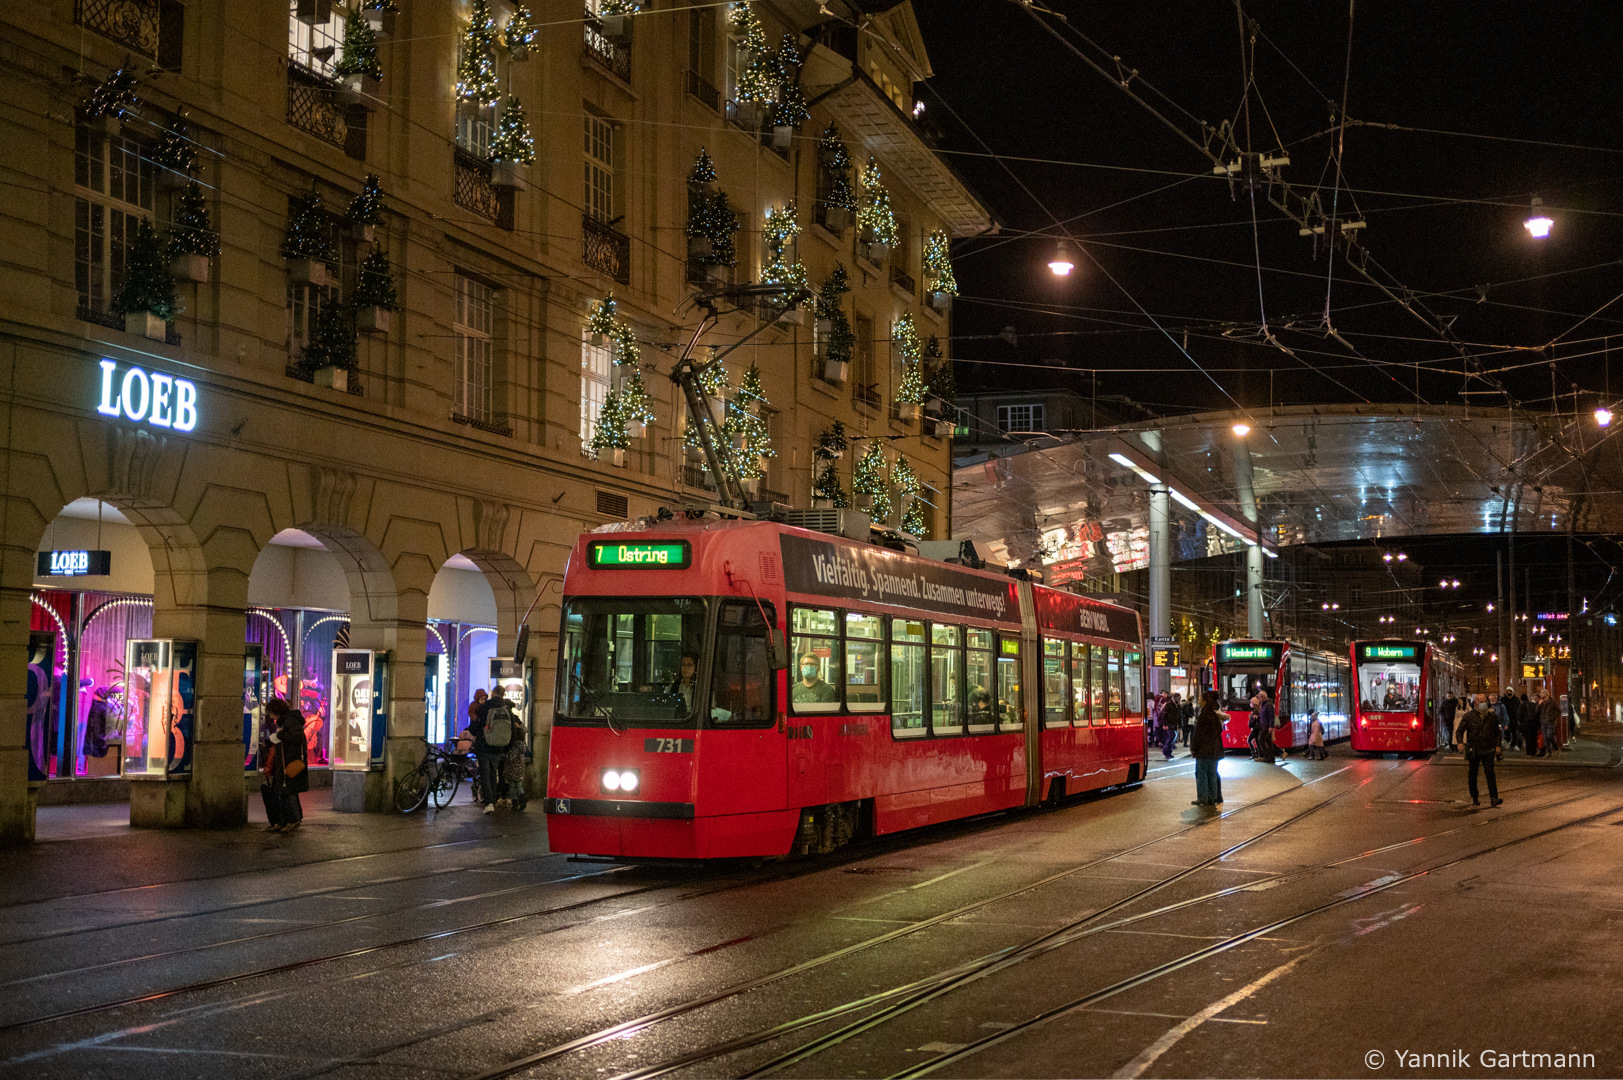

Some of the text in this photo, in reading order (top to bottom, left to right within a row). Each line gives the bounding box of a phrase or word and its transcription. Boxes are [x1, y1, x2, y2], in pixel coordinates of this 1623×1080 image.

[97, 359, 197, 433] LOEB
[50, 551, 89, 570] LOEB
[595, 545, 668, 564] 7 Ostring
[812, 554, 1006, 617] Vielfältig. Spannend. Zusammen unterwegs!
[1226, 647, 1267, 658] 9 Wankdorf Bhf
[1365, 646, 1403, 657] 9 Wabern
[345, 661, 362, 669] LOEB
[656, 738, 682, 753] 731
